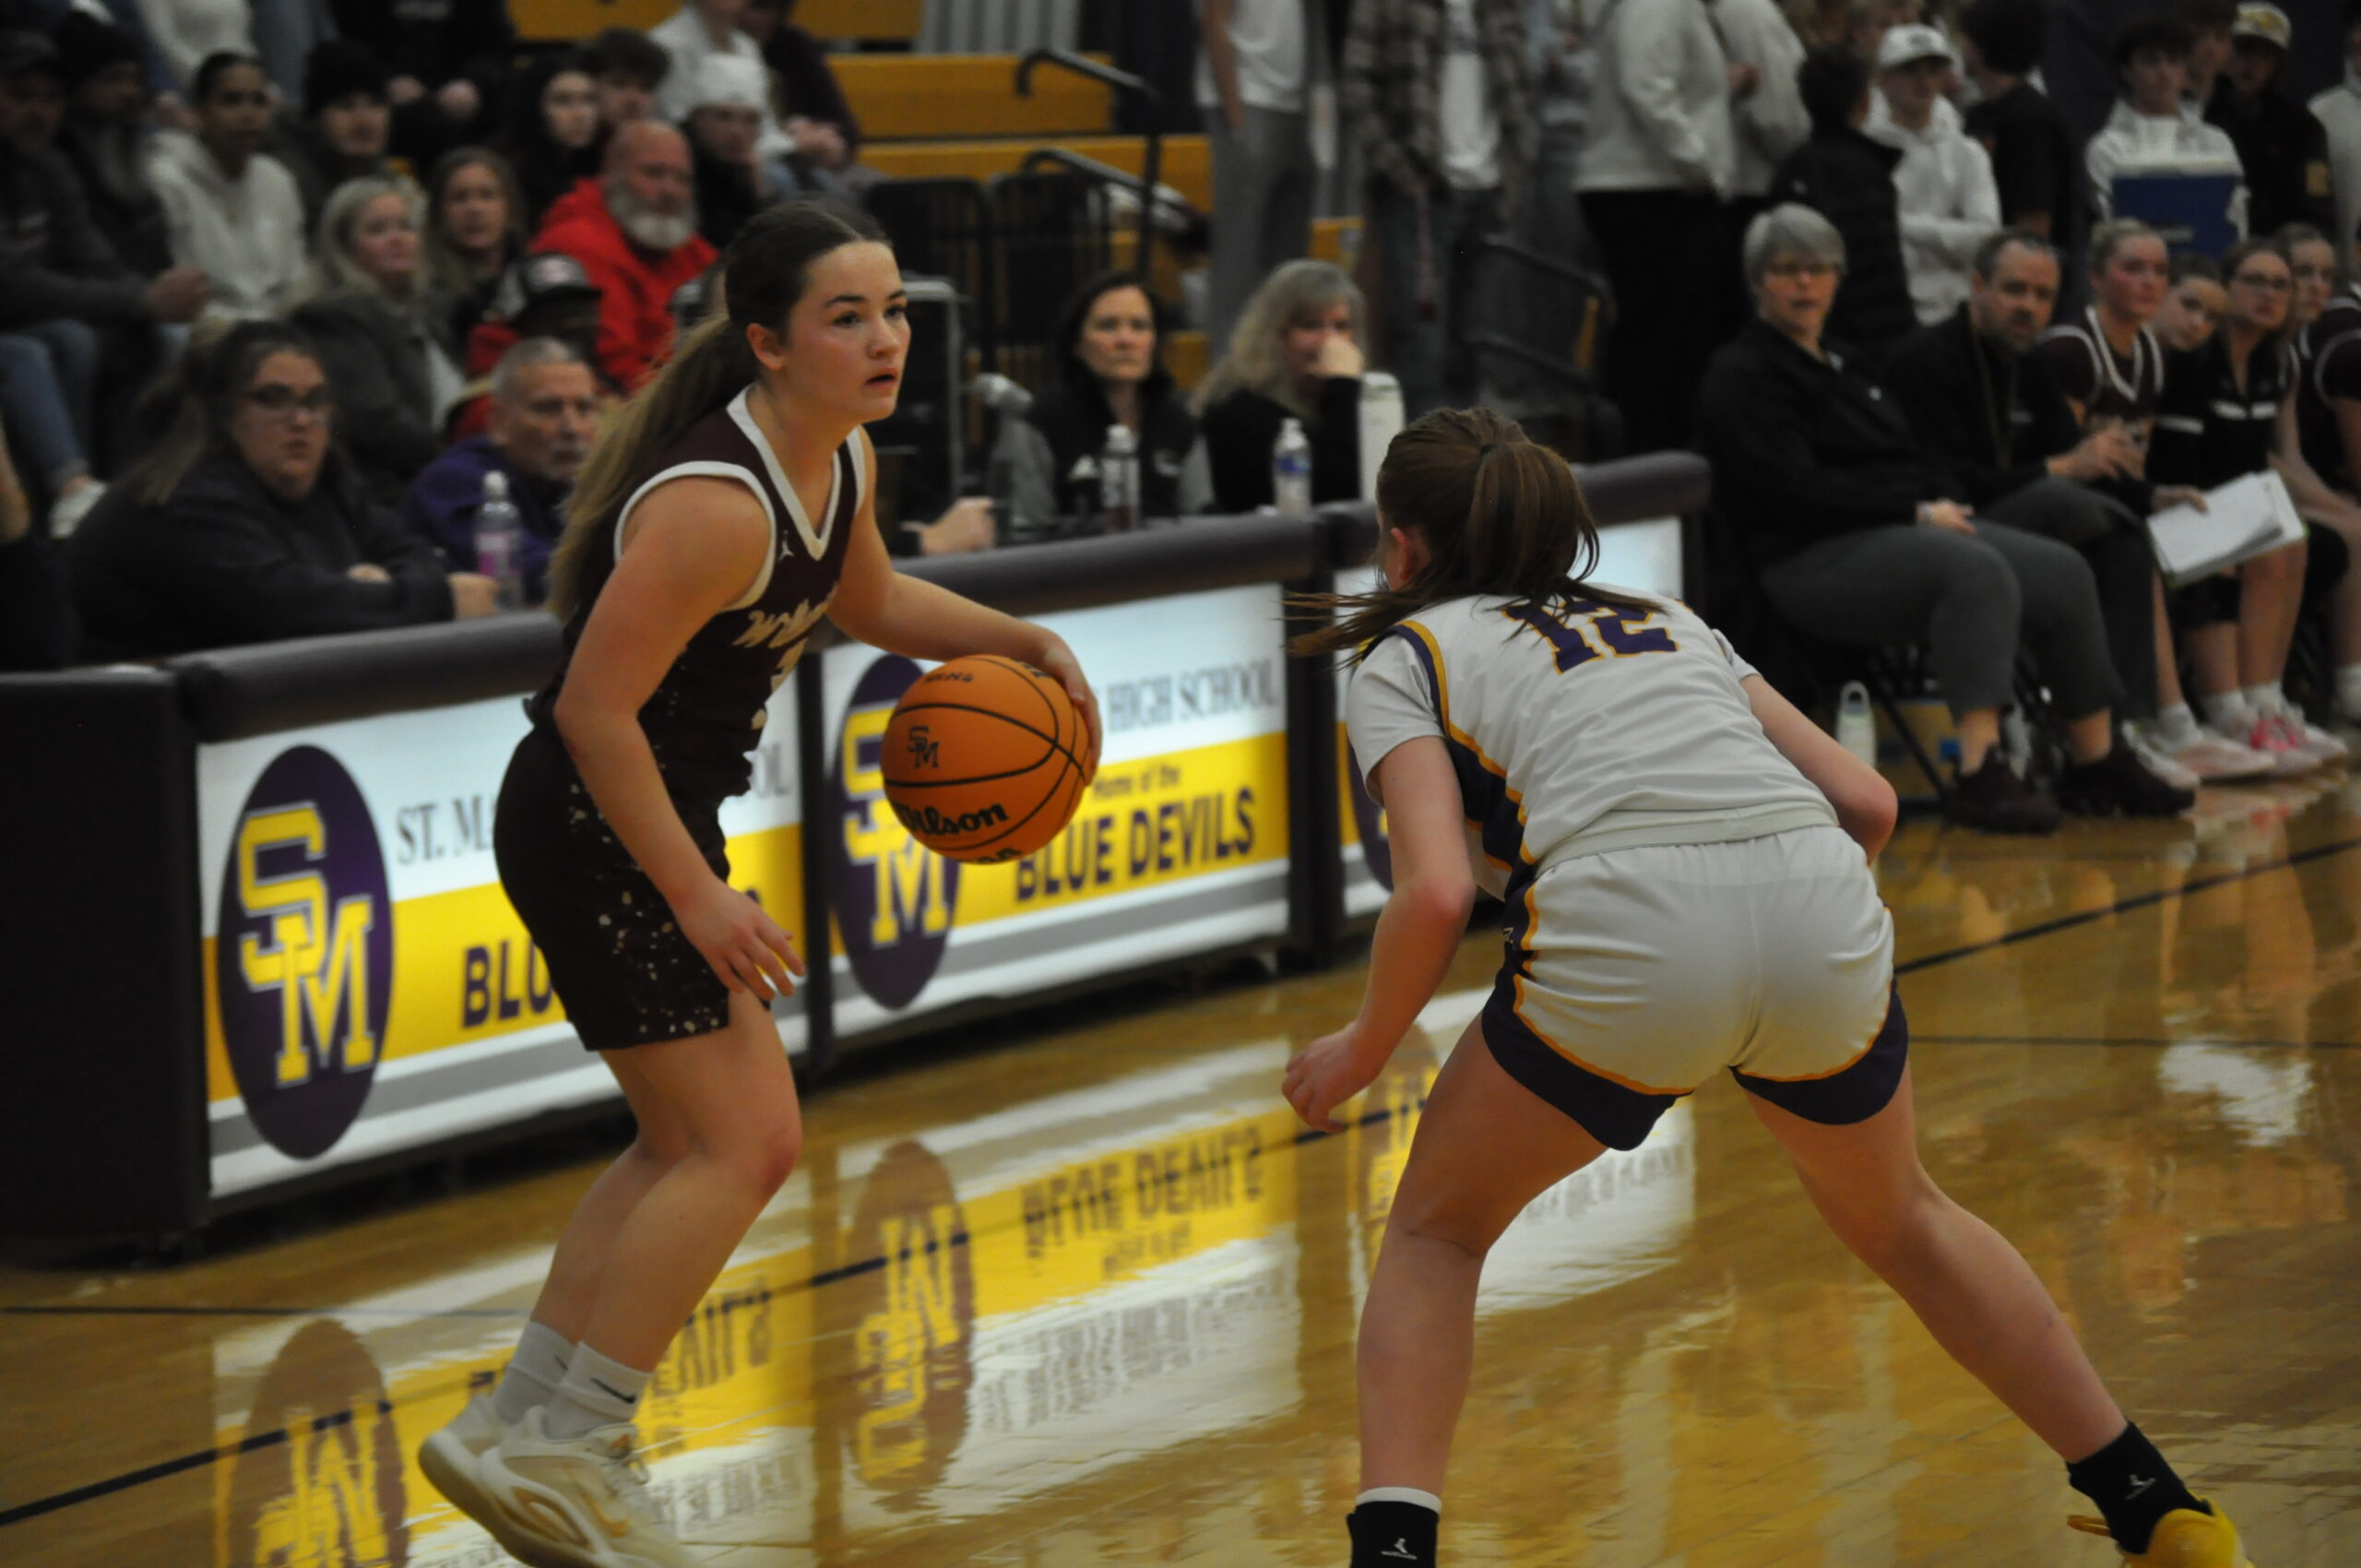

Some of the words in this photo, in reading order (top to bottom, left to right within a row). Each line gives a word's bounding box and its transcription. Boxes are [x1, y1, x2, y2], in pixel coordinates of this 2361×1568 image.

[1108, 672, 1173, 734] HIGH
[1179, 657, 1280, 720] SCHOOL
[907, 725, 940, 769] SM
[396, 802, 444, 867] ST.
[1129, 786, 1255, 880] DEVILS
[237, 799, 376, 1088] SM
[463, 935, 554, 1030] BLU
